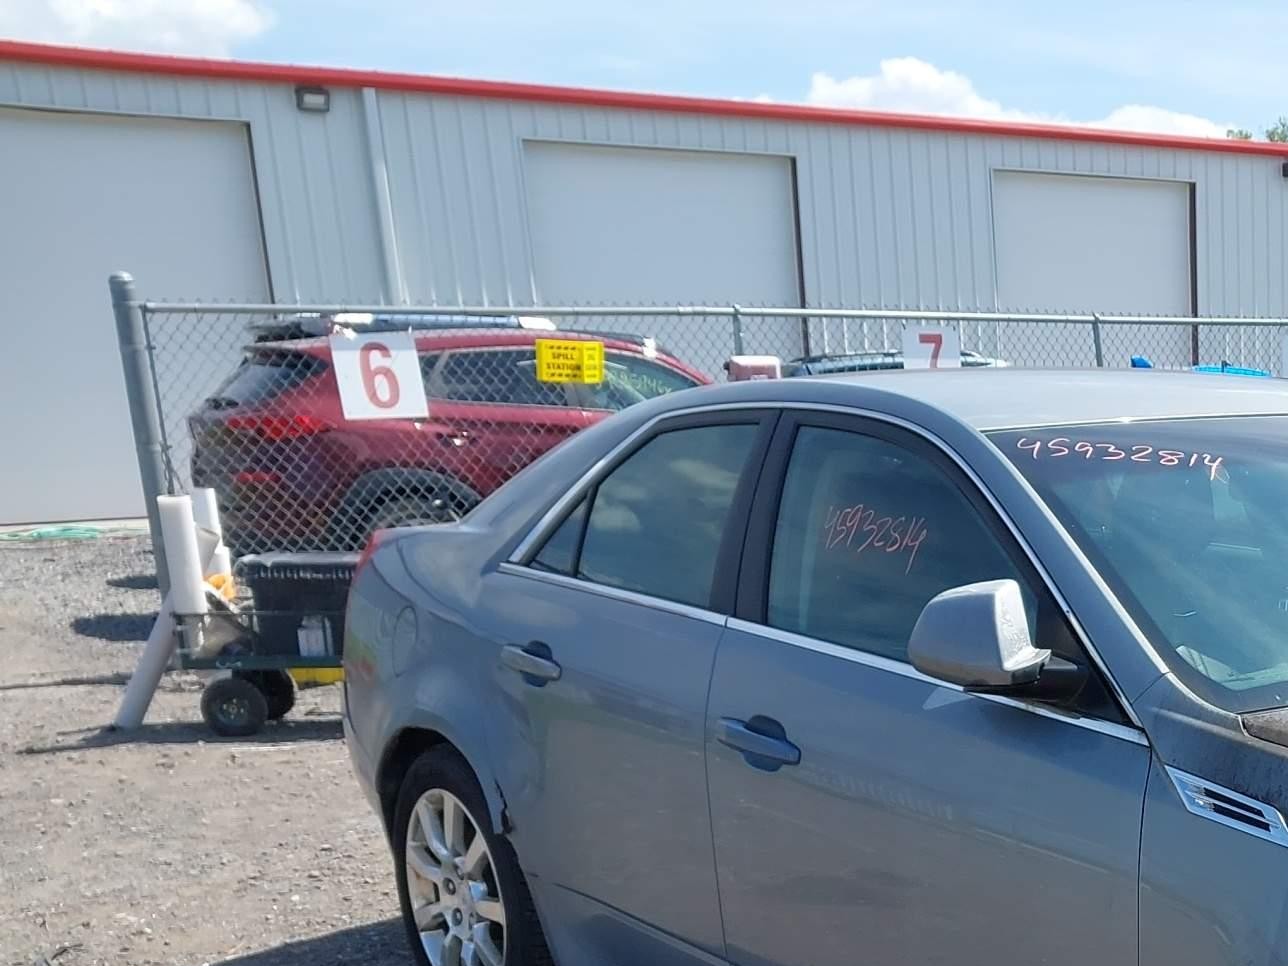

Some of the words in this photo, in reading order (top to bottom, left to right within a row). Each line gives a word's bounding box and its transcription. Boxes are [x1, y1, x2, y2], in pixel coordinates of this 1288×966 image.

[551, 352, 576, 361] SPILL
[919, 334, 942, 369] 7
[360, 342, 400, 408] 6
[1017, 438, 1223, 480] 45932814
